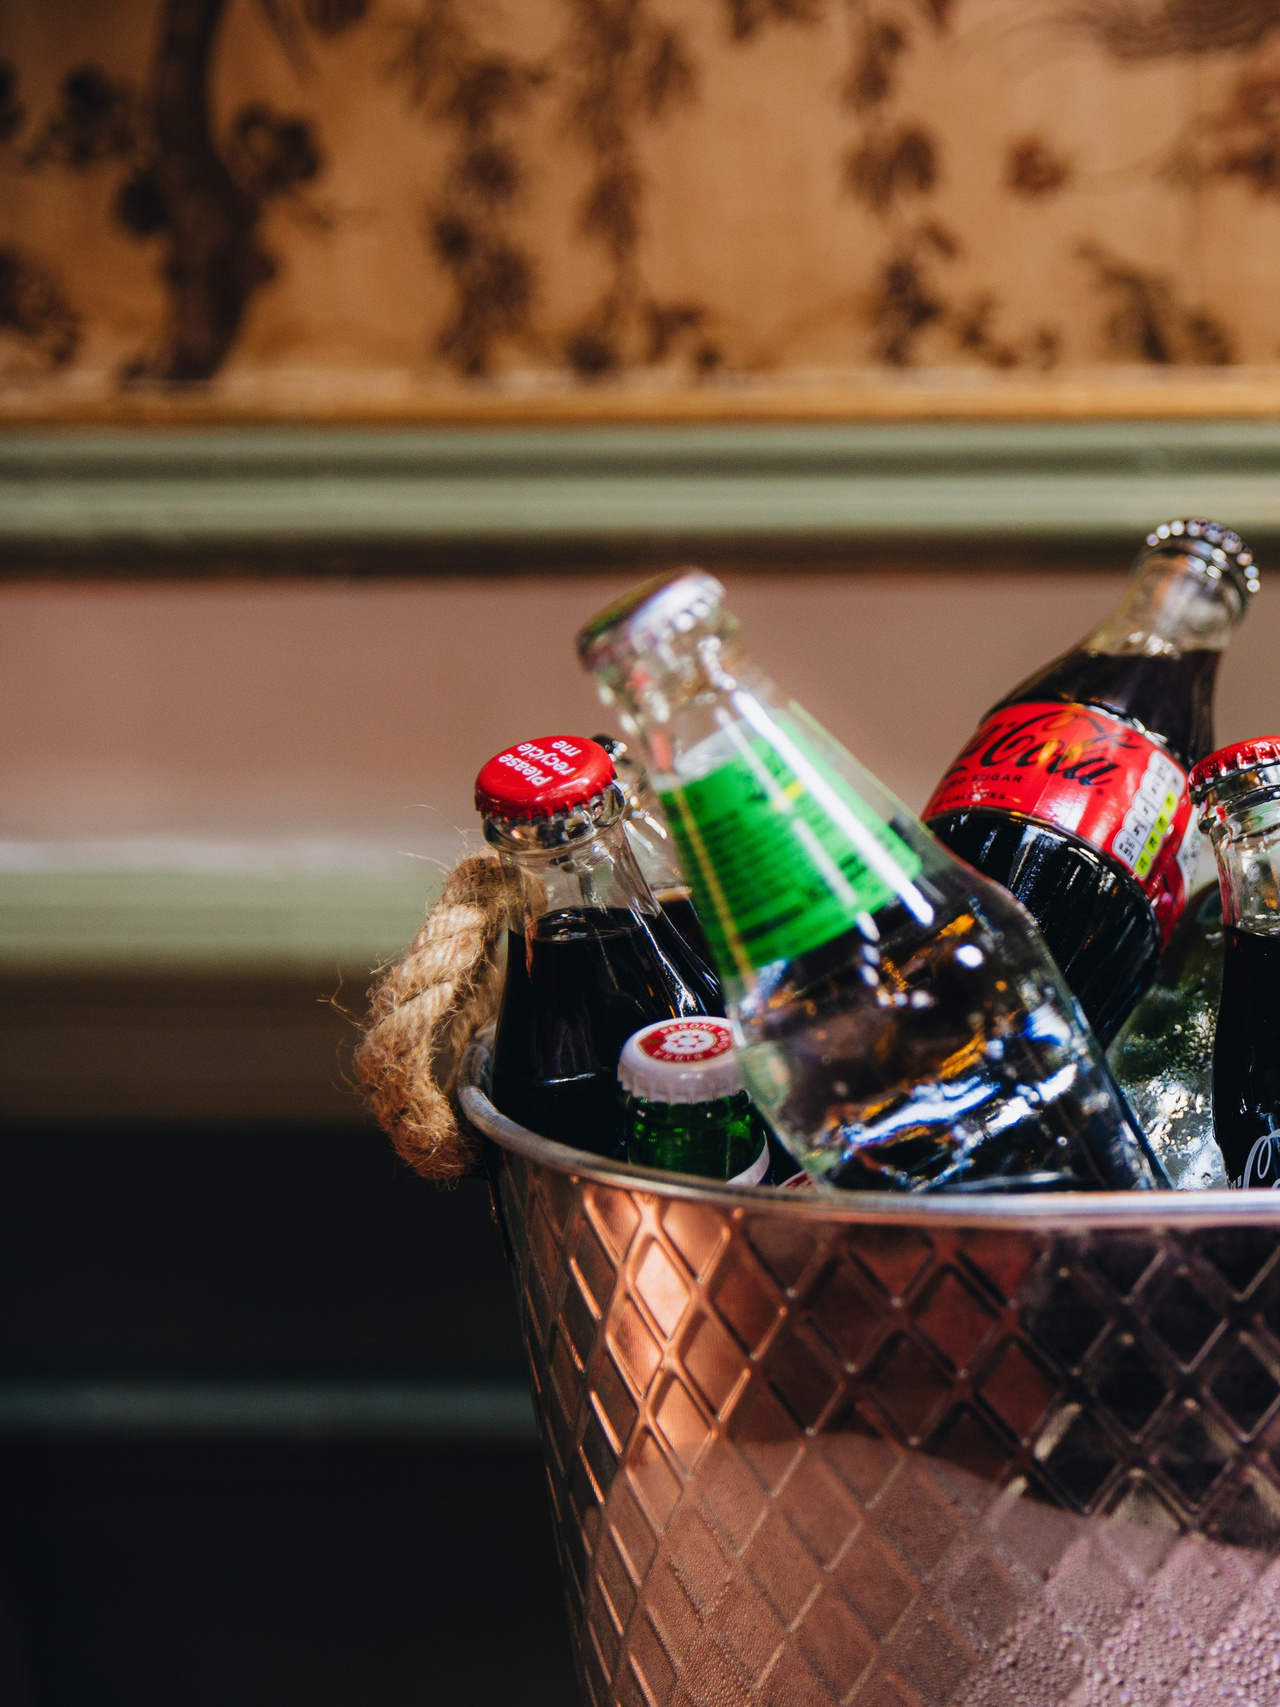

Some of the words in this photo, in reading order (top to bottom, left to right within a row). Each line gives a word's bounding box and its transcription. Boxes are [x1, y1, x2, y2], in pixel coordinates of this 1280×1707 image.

[517, 743, 576, 775] recycle
[551, 740, 582, 757] me
[498, 753, 553, 786] Please
[660, 1023, 716, 1034] PERONI
